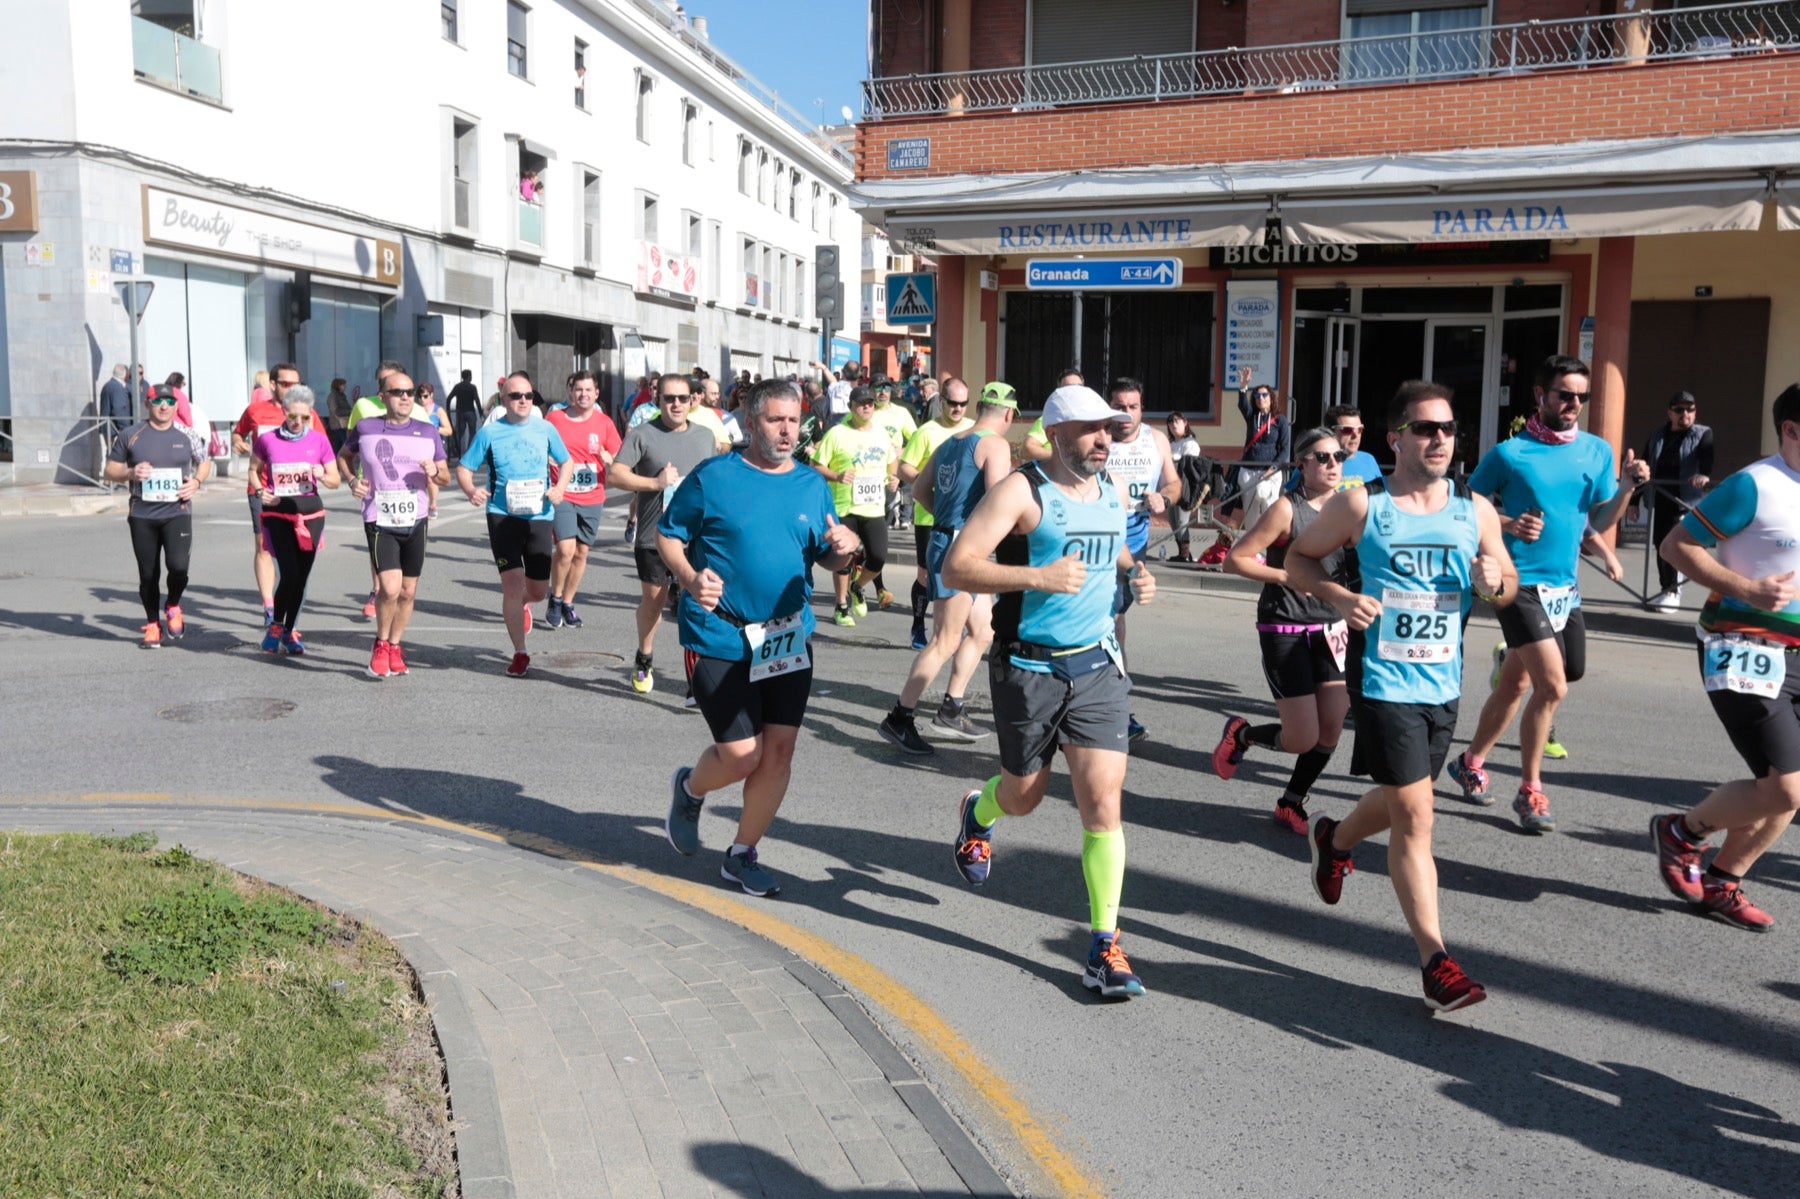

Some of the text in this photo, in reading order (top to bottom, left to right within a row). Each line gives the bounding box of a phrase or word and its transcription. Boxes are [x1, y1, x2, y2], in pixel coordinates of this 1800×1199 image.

[897, 140, 928, 149] AVENIDA
[900, 148, 926, 158] JACOBO
[890, 157, 928, 168] CAMARERO
[162, 197, 234, 247] Beauty
[1432, 205, 1569, 235] PARADA
[246, 230, 303, 251] THE SHOP
[998, 218, 1192, 249] RESTAURANTE
[384, 247, 395, 277] B
[1223, 243, 1358, 264] BICHITOS
[1030, 267, 1151, 281] Granada A-44
[1107, 458, 1152, 466] ARACENA
[146, 479, 180, 491] 1183
[858, 484, 882, 495] 3001
[381, 501, 415, 514] 3169
[1395, 613, 1449, 640] 825
[761, 631, 796, 660] 677
[1716, 650, 1772, 676] 219
